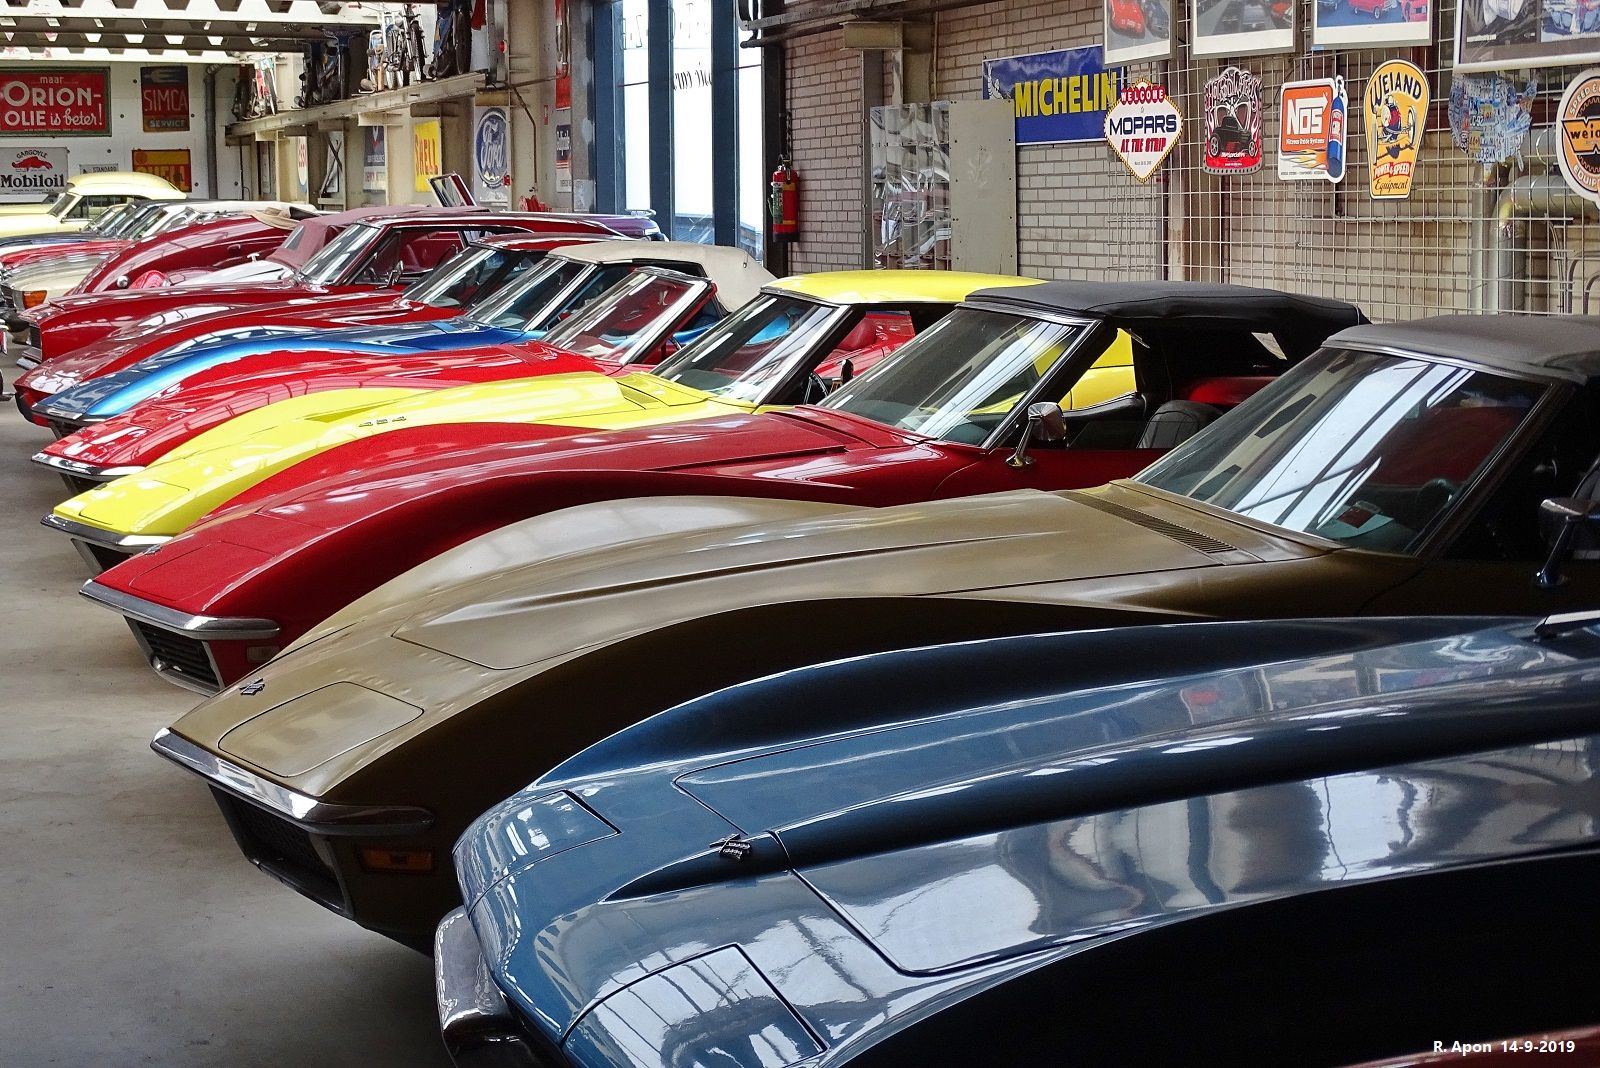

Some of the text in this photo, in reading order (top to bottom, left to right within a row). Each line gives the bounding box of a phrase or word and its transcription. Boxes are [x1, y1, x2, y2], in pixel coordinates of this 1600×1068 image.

[40, 76, 64, 84] maar
[3, 81, 102, 107] ORION-
[143, 88, 188, 112] SIMCA
[1014, 71, 1118, 118] MICHELIN
[1121, 88, 1165, 102] WELCOME
[1370, 72, 1422, 114] WEIAND
[1570, 87, 1591, 115] SPEED
[4, 111, 47, 126] OLIE
[50, 113, 61, 126] is
[1286, 91, 1329, 135] NOS
[148, 119, 185, 128] SERVICE
[1109, 114, 1178, 136] MOPARS
[16, 149, 48, 159] GARGOYLE
[415, 132, 439, 176] SHELL
[480, 120, 505, 170] Ford
[1120, 137, 1167, 153] AT THE STRIP
[1393, 162, 1410, 175] SPEED
[0, 174, 65, 188] Mobiloil
[1374, 179, 1409, 195] Equipment
